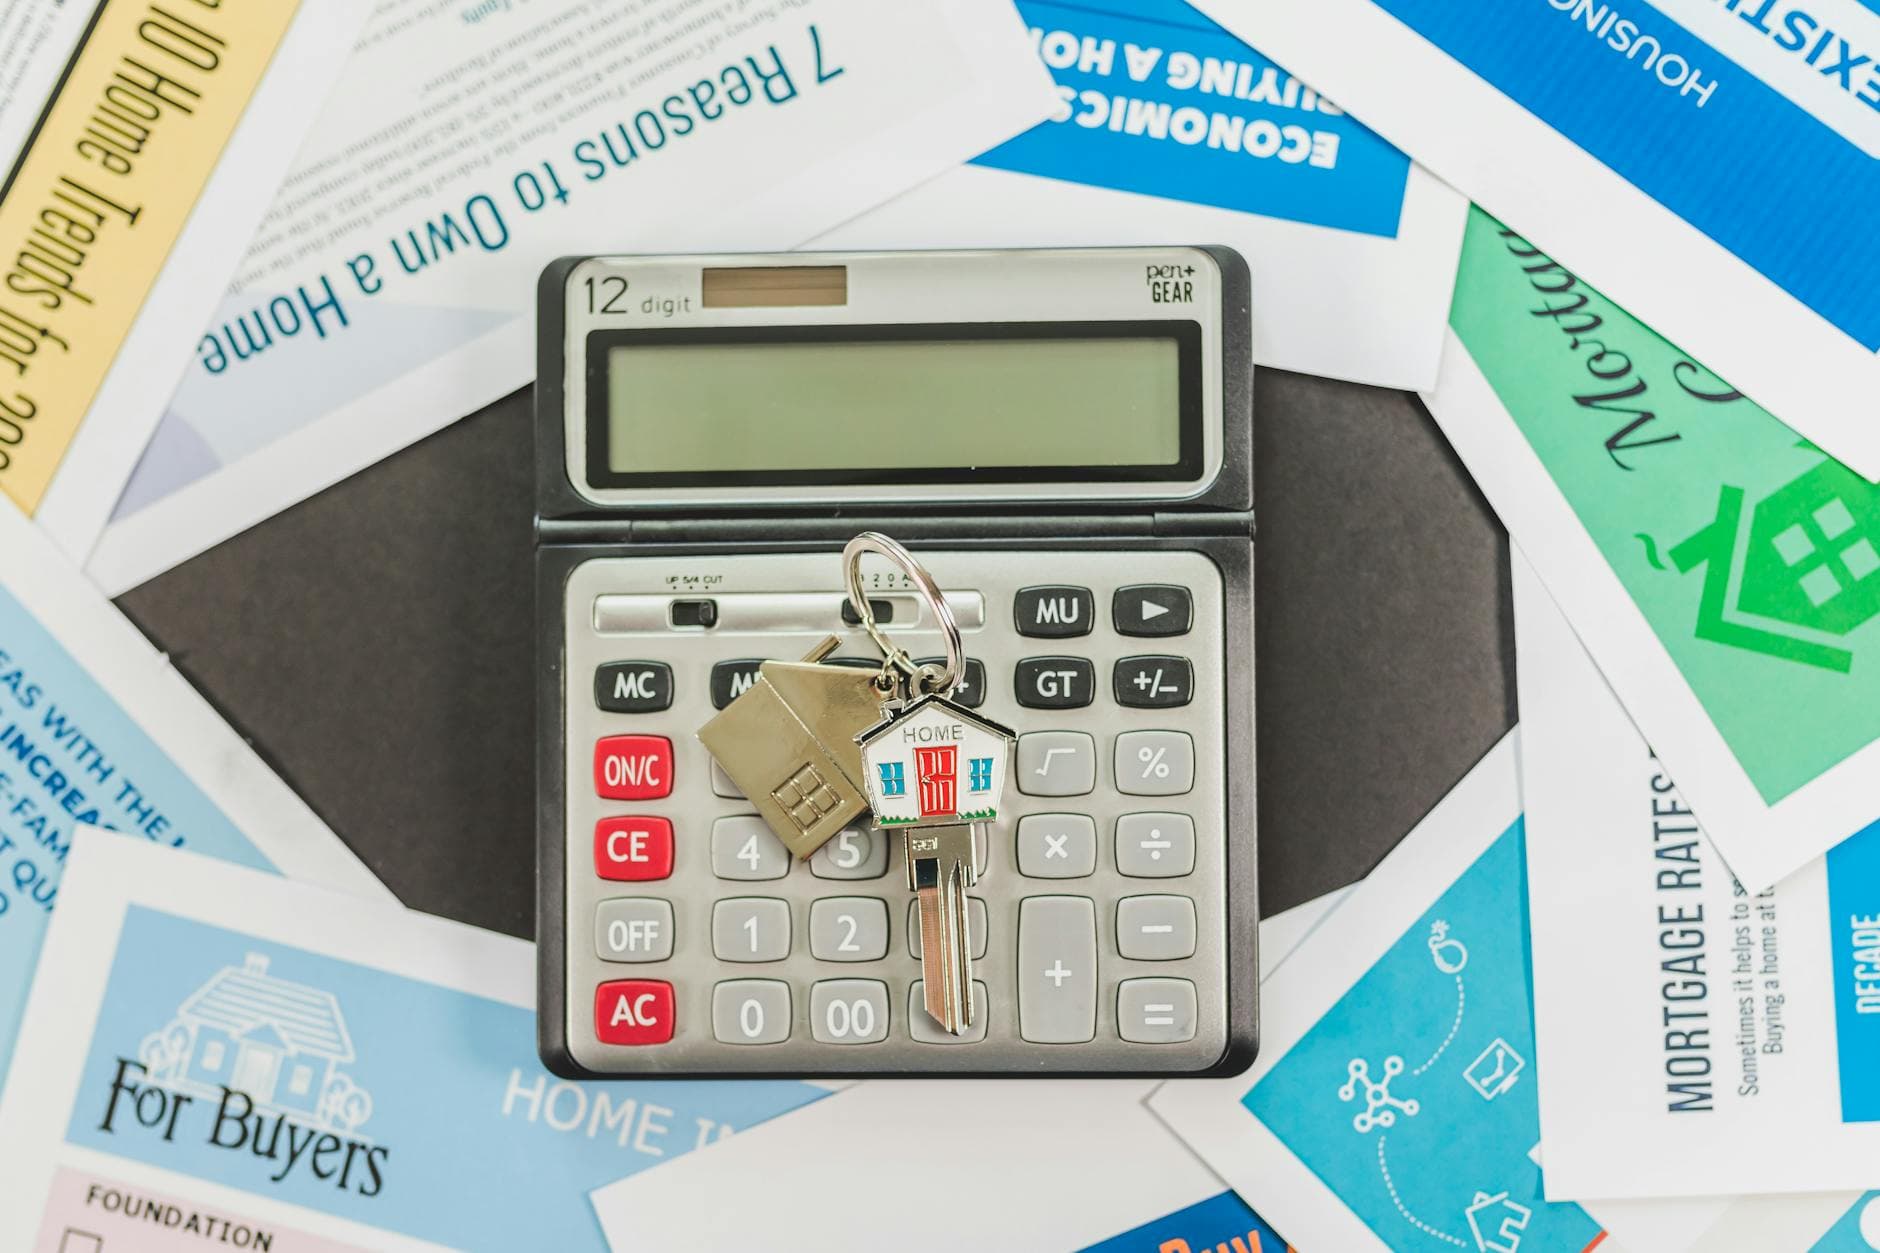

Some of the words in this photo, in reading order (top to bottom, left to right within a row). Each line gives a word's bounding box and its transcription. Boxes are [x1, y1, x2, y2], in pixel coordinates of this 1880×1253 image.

[138, 5, 226, 71] 10
[809, 25, 844, 84] 7
[1725, 0, 1880, 113] XIST
[1123, 43, 1163, 82] A
[76, 55, 203, 176] Home
[575, 46, 797, 180] Reasons
[1051, 85, 1341, 170] ECONOMICS
[514, 162, 568, 211] to
[6, 176, 143, 310] Trends
[391, 195, 509, 273] Own
[347, 254, 382, 295] a
[1152, 281, 1193, 303] GEAR
[585, 276, 628, 314] 12
[641, 297, 691, 317] digit
[198, 276, 348, 373] Home
[1035, 597, 1079, 624] MU
[613, 672, 656, 699] MC
[1036, 671, 1078, 697] GT
[904, 725, 964, 743] HOME
[0, 723, 120, 832] INCREA
[42, 704, 115, 783] WITH
[114, 777, 173, 841] THE
[604, 754, 660, 786] ON/C
[607, 831, 649, 863] CE
[737, 834, 760, 870] 4
[837, 831, 861, 868] 5
[1730, 904, 1750, 921] to
[1756, 902, 1775, 921] at
[608, 920, 659, 951] OFF
[743, 915, 758, 952] 1
[837, 915, 861, 951] 2
[1731, 925, 1755, 974] helps
[1759, 926, 1779, 975] home
[1733, 977, 1753, 992] it
[1765, 979, 1779, 990] a
[610, 993, 657, 1026] AC
[740, 999, 764, 1037] 0
[826, 999, 875, 1037] 00
[1658, 904, 1714, 1113] MORTGAGE
[1762, 994, 1785, 1055] Buying
[1737, 996, 1759, 1097] Sometimes
[98, 1056, 194, 1141] For
[208, 1084, 390, 1198] Buyers
[501, 1068, 674, 1157] HOME
[85, 1184, 274, 1253] FOUNDATION
